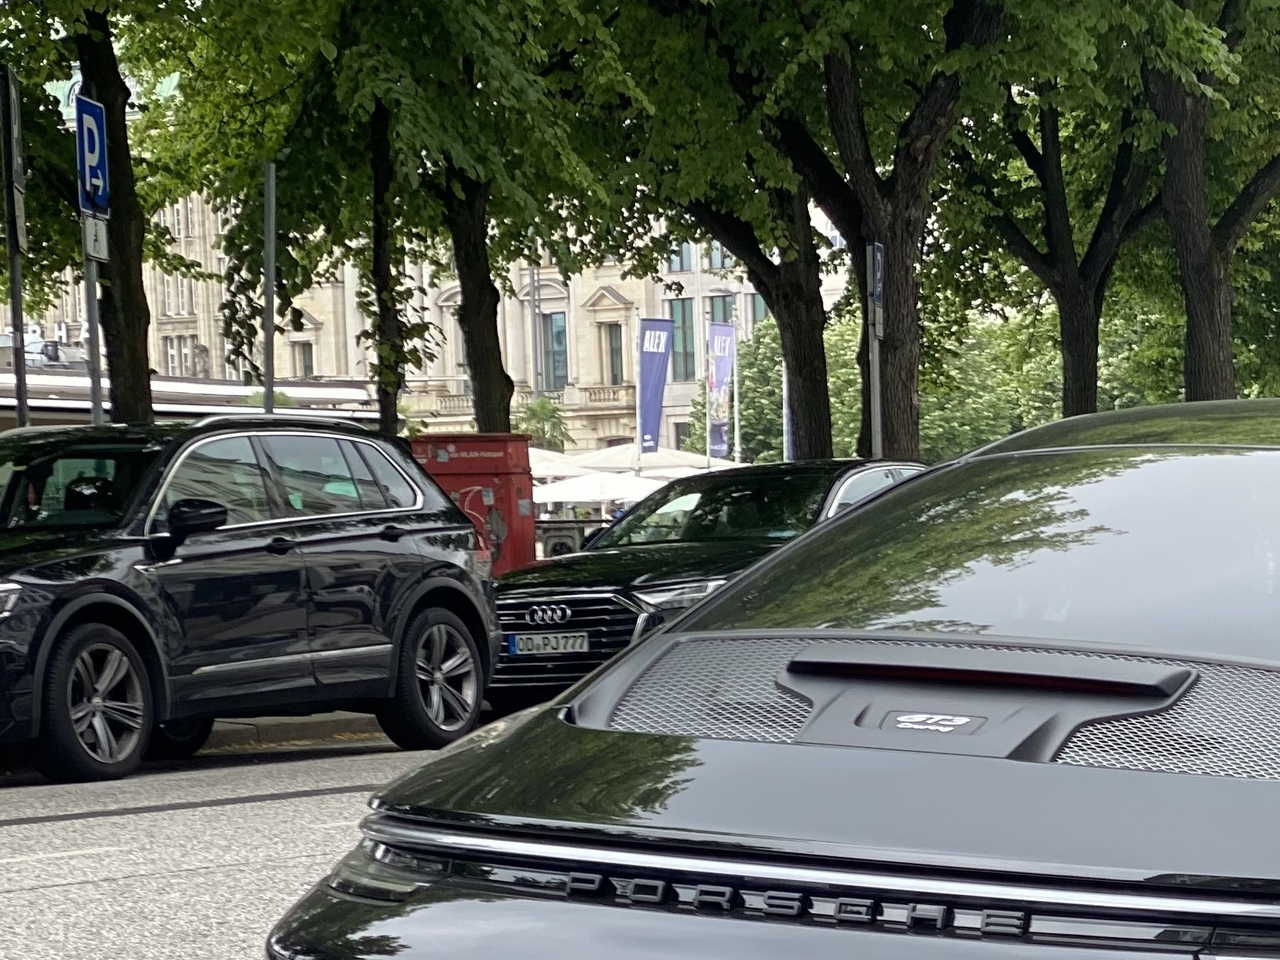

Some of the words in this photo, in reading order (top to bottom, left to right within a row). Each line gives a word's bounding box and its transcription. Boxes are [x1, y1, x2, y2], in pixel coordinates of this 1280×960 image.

[82, 113, 101, 192] P
[643, 330, 668, 352] ALEX
[896, 714, 970, 726] GT3
[565, 871, 1031, 936] PORSCHE
